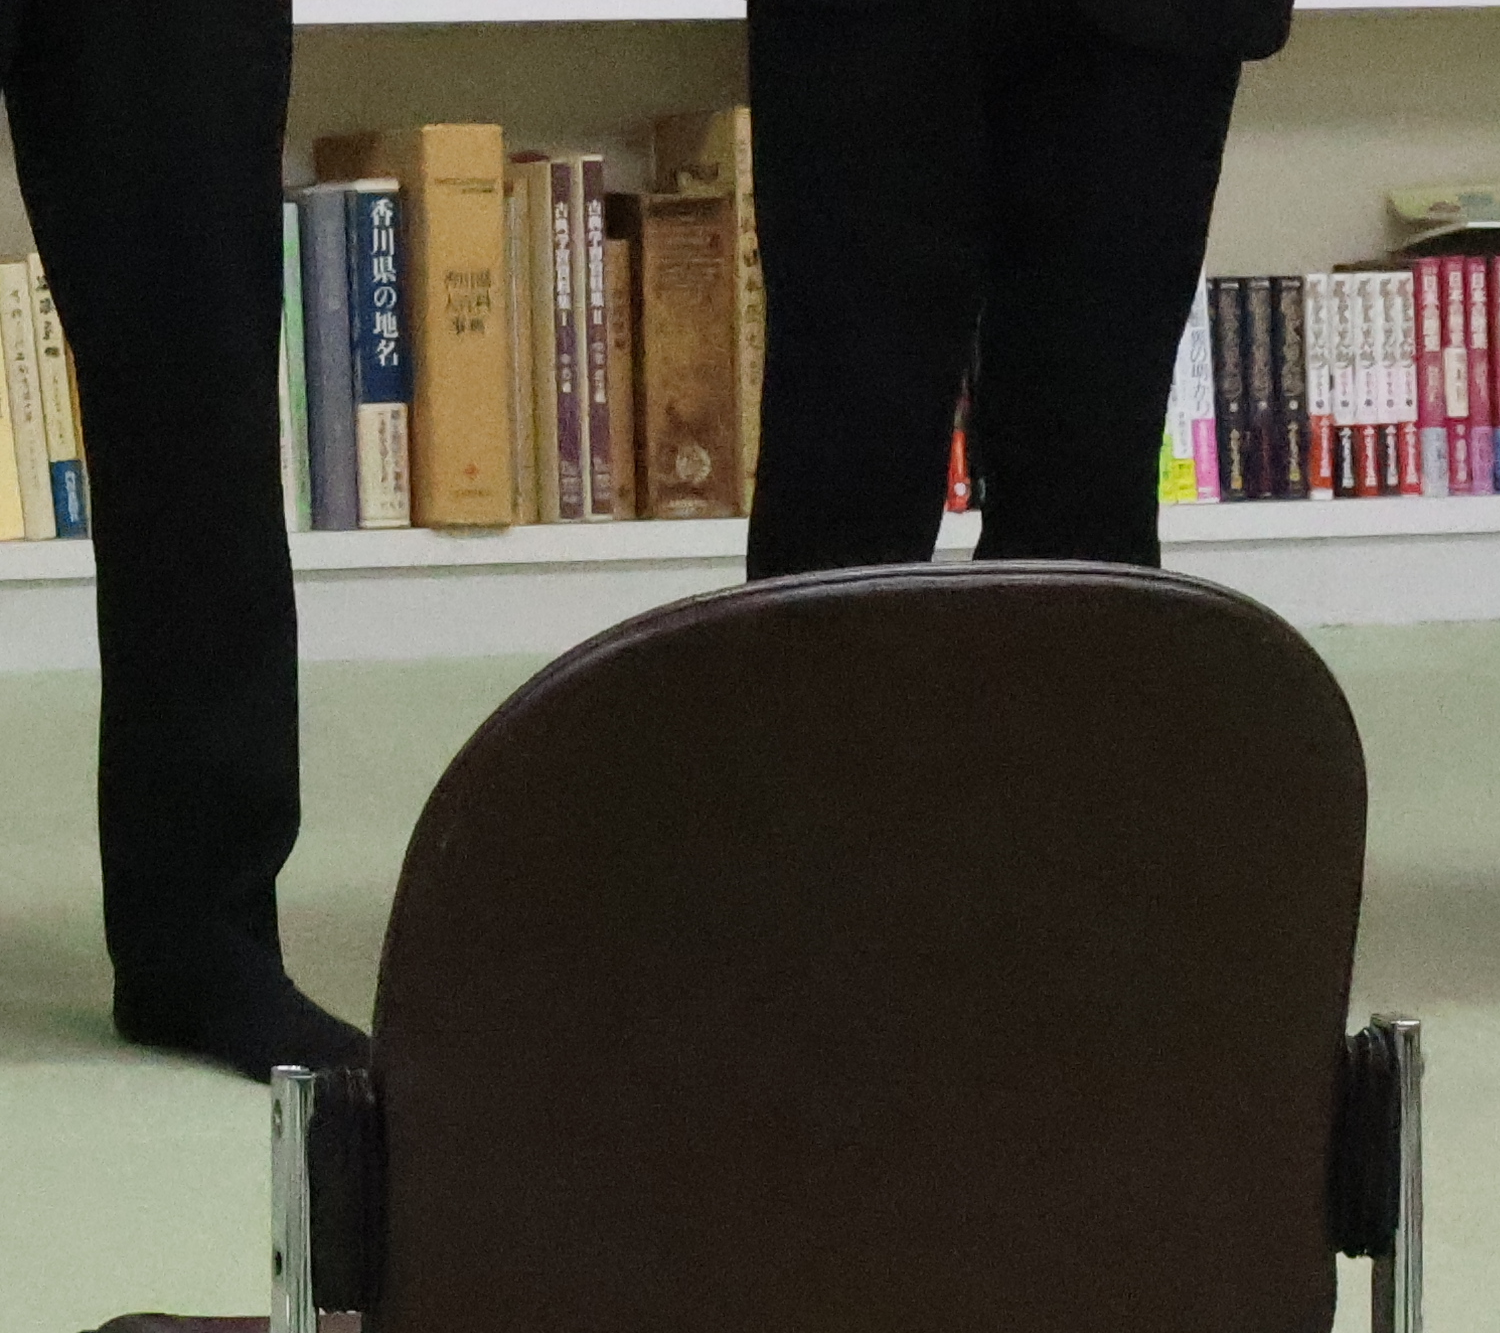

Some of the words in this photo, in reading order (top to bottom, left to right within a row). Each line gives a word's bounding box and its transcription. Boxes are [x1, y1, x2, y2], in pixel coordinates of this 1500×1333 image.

[370, 198, 399, 367] 香川県の地名
